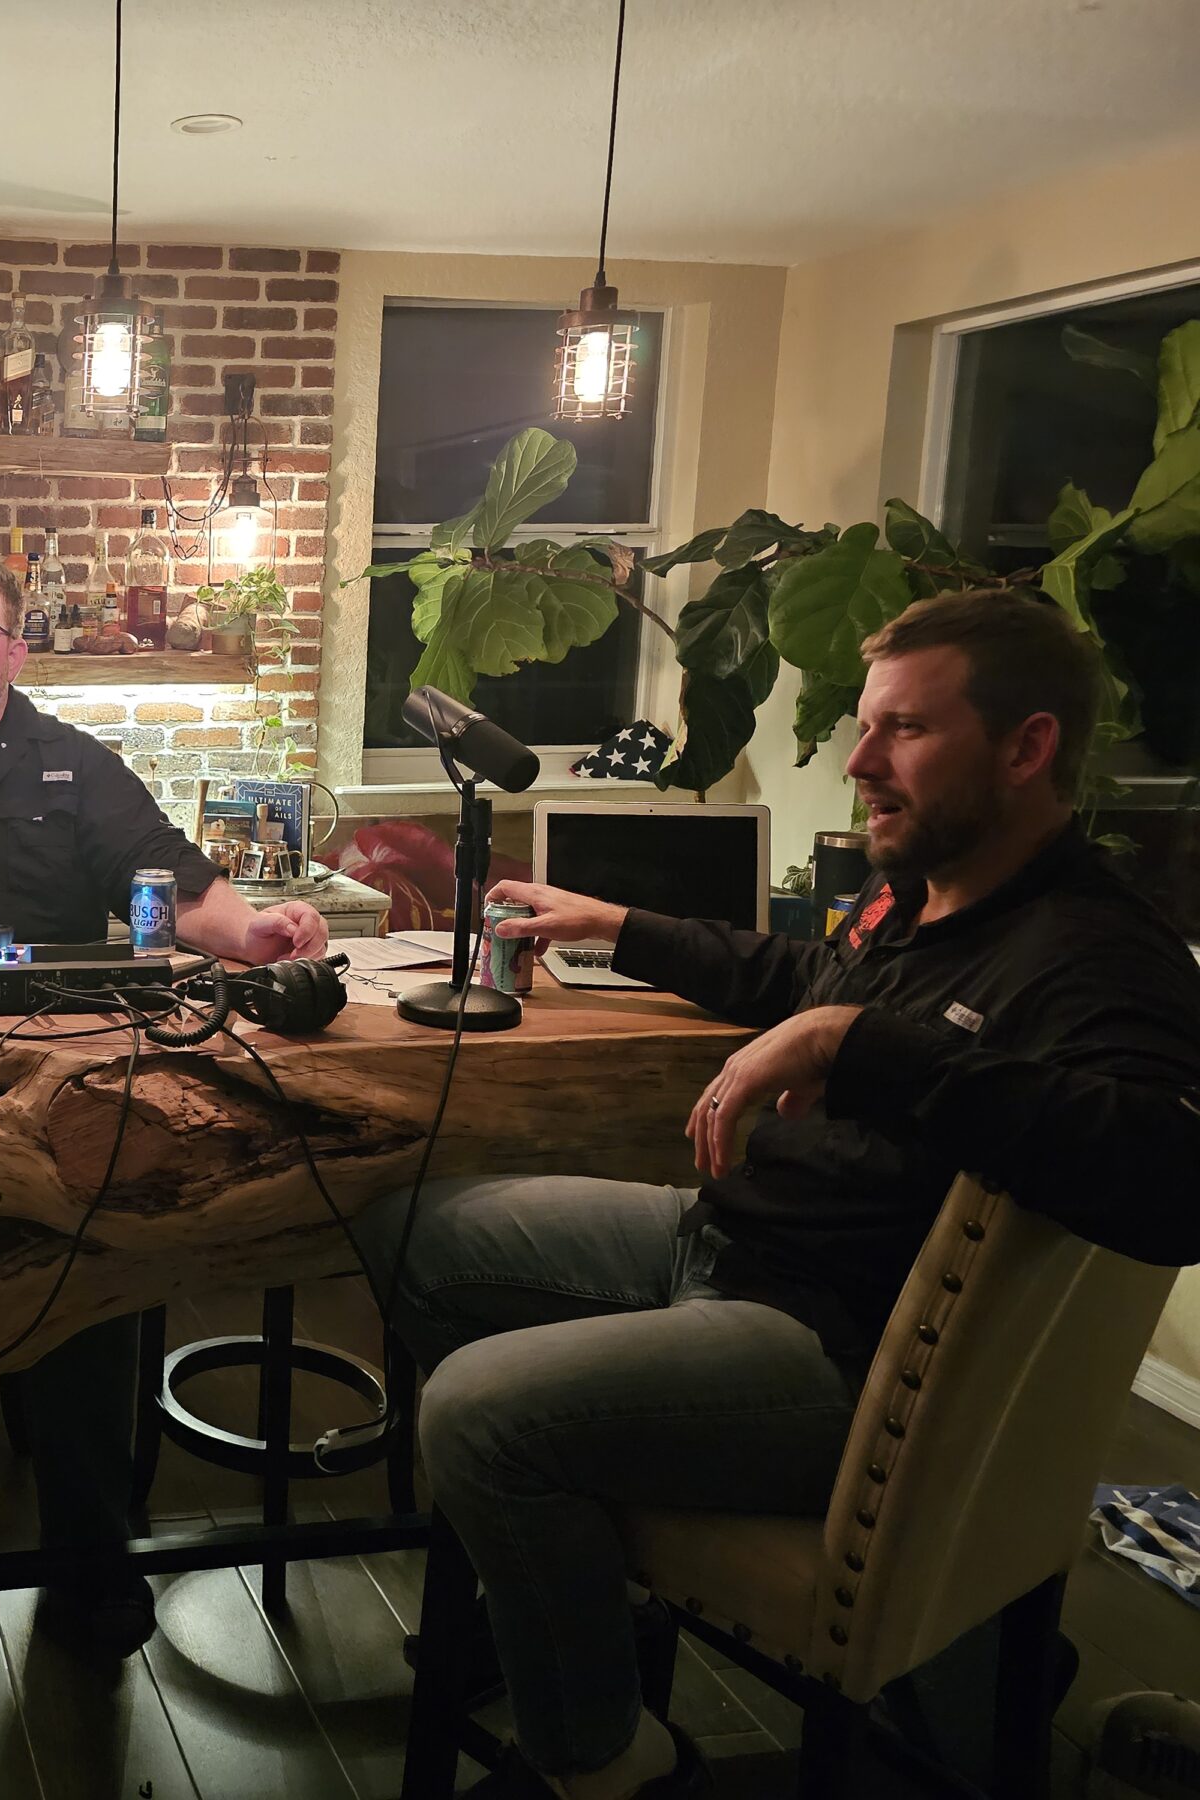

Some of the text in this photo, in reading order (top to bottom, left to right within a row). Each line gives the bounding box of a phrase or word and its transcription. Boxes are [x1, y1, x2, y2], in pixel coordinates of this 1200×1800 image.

[248, 796, 292, 806] ULTIMATE
[130, 904, 168, 920] BUSCH
[134, 919, 159, 927] LIGHT
